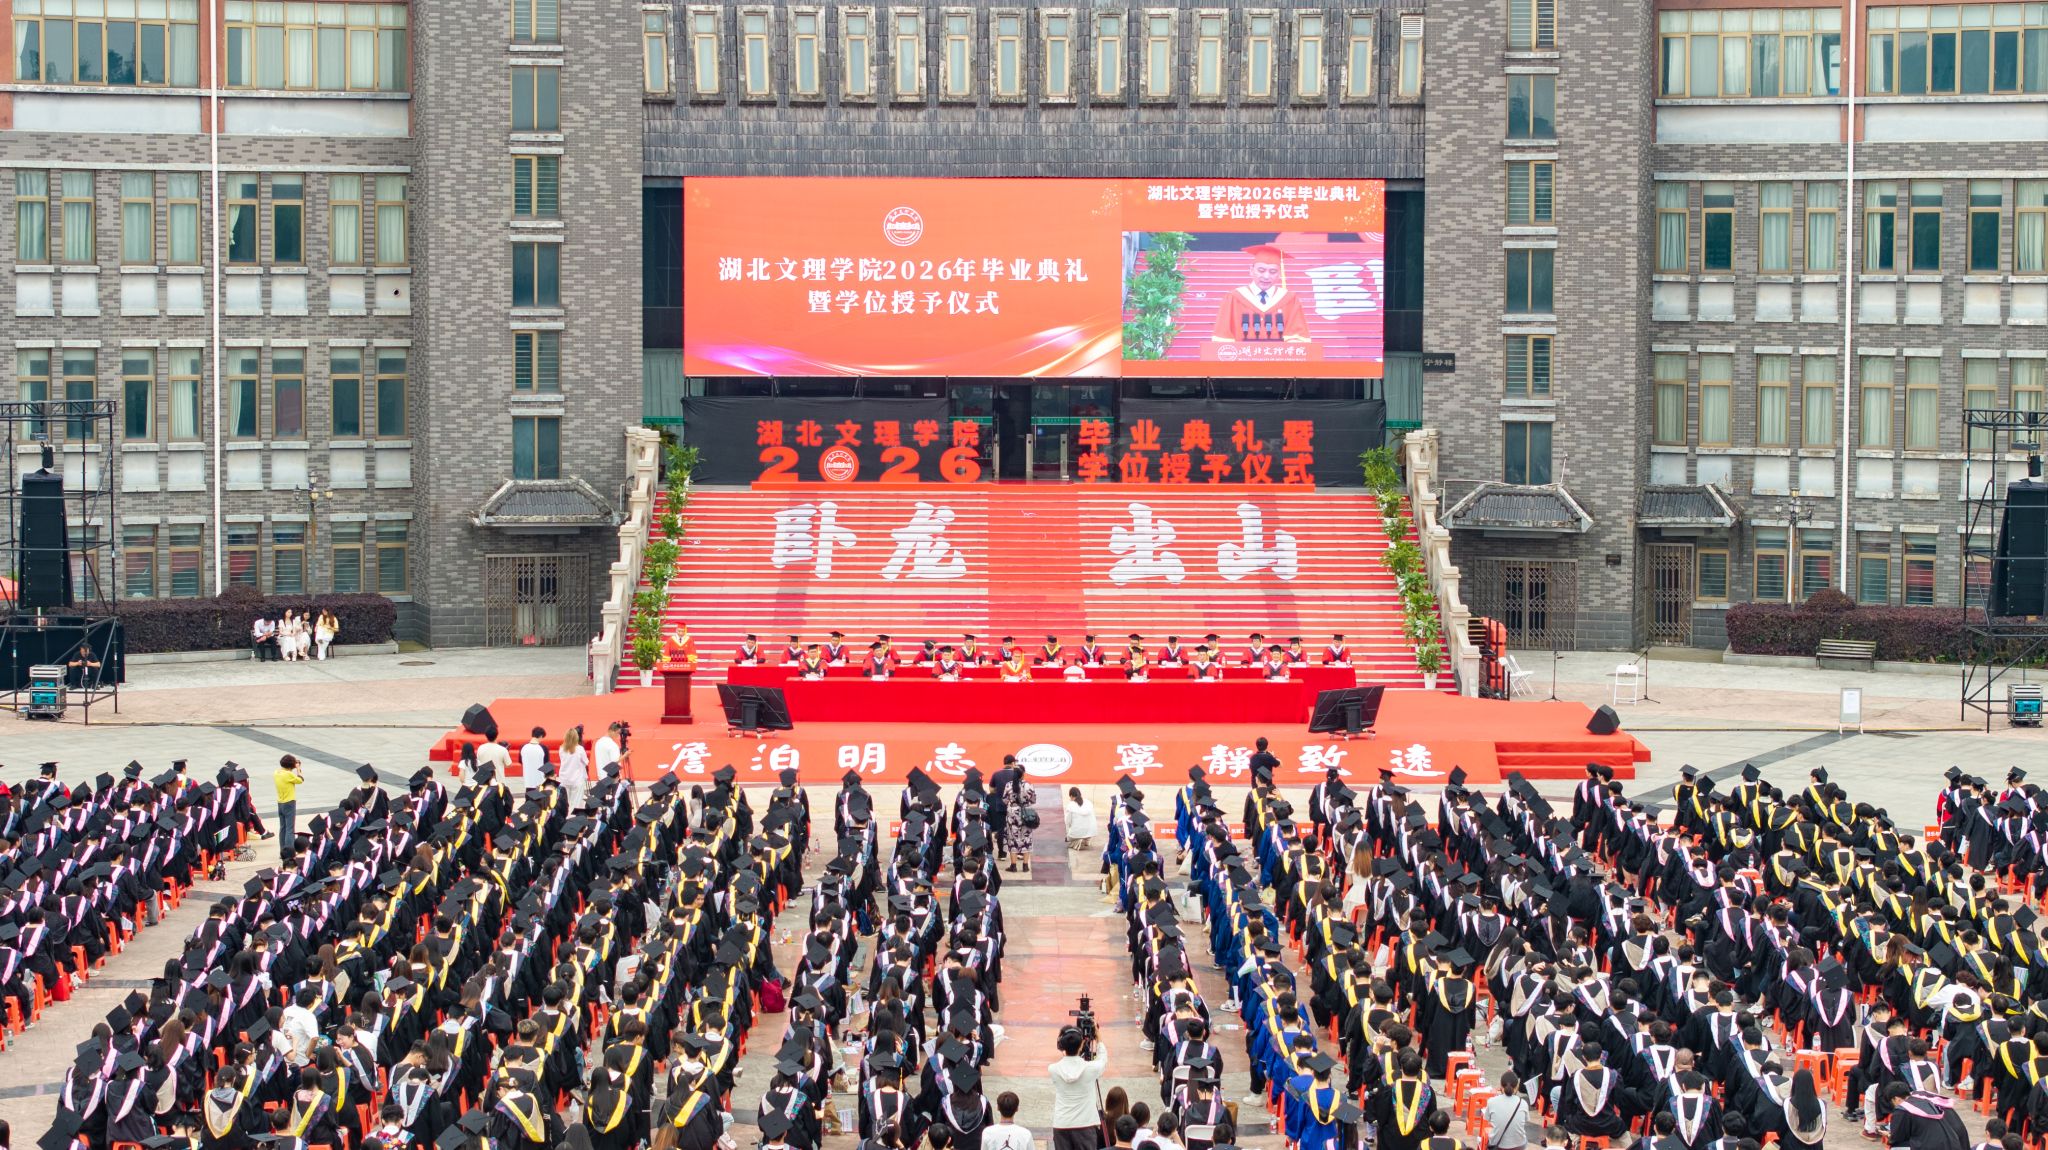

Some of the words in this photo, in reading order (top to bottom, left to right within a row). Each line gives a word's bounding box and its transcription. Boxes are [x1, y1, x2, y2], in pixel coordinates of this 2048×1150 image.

[1148, 185, 1361, 202] 湖北文理学院2026年毕业典礼
[1198, 203, 1309, 220] 暨学位授予仪式
[718, 256, 1089, 282] 湖北文理学院2026年毕业典礼
[808, 290, 1000, 315] 暨学位授予仪式
[757, 420, 980, 447] 湖北文理学院
[1078, 419, 1314, 452] 毕业典礼暨
[1078, 452, 1314, 483] 学位授予仪式
